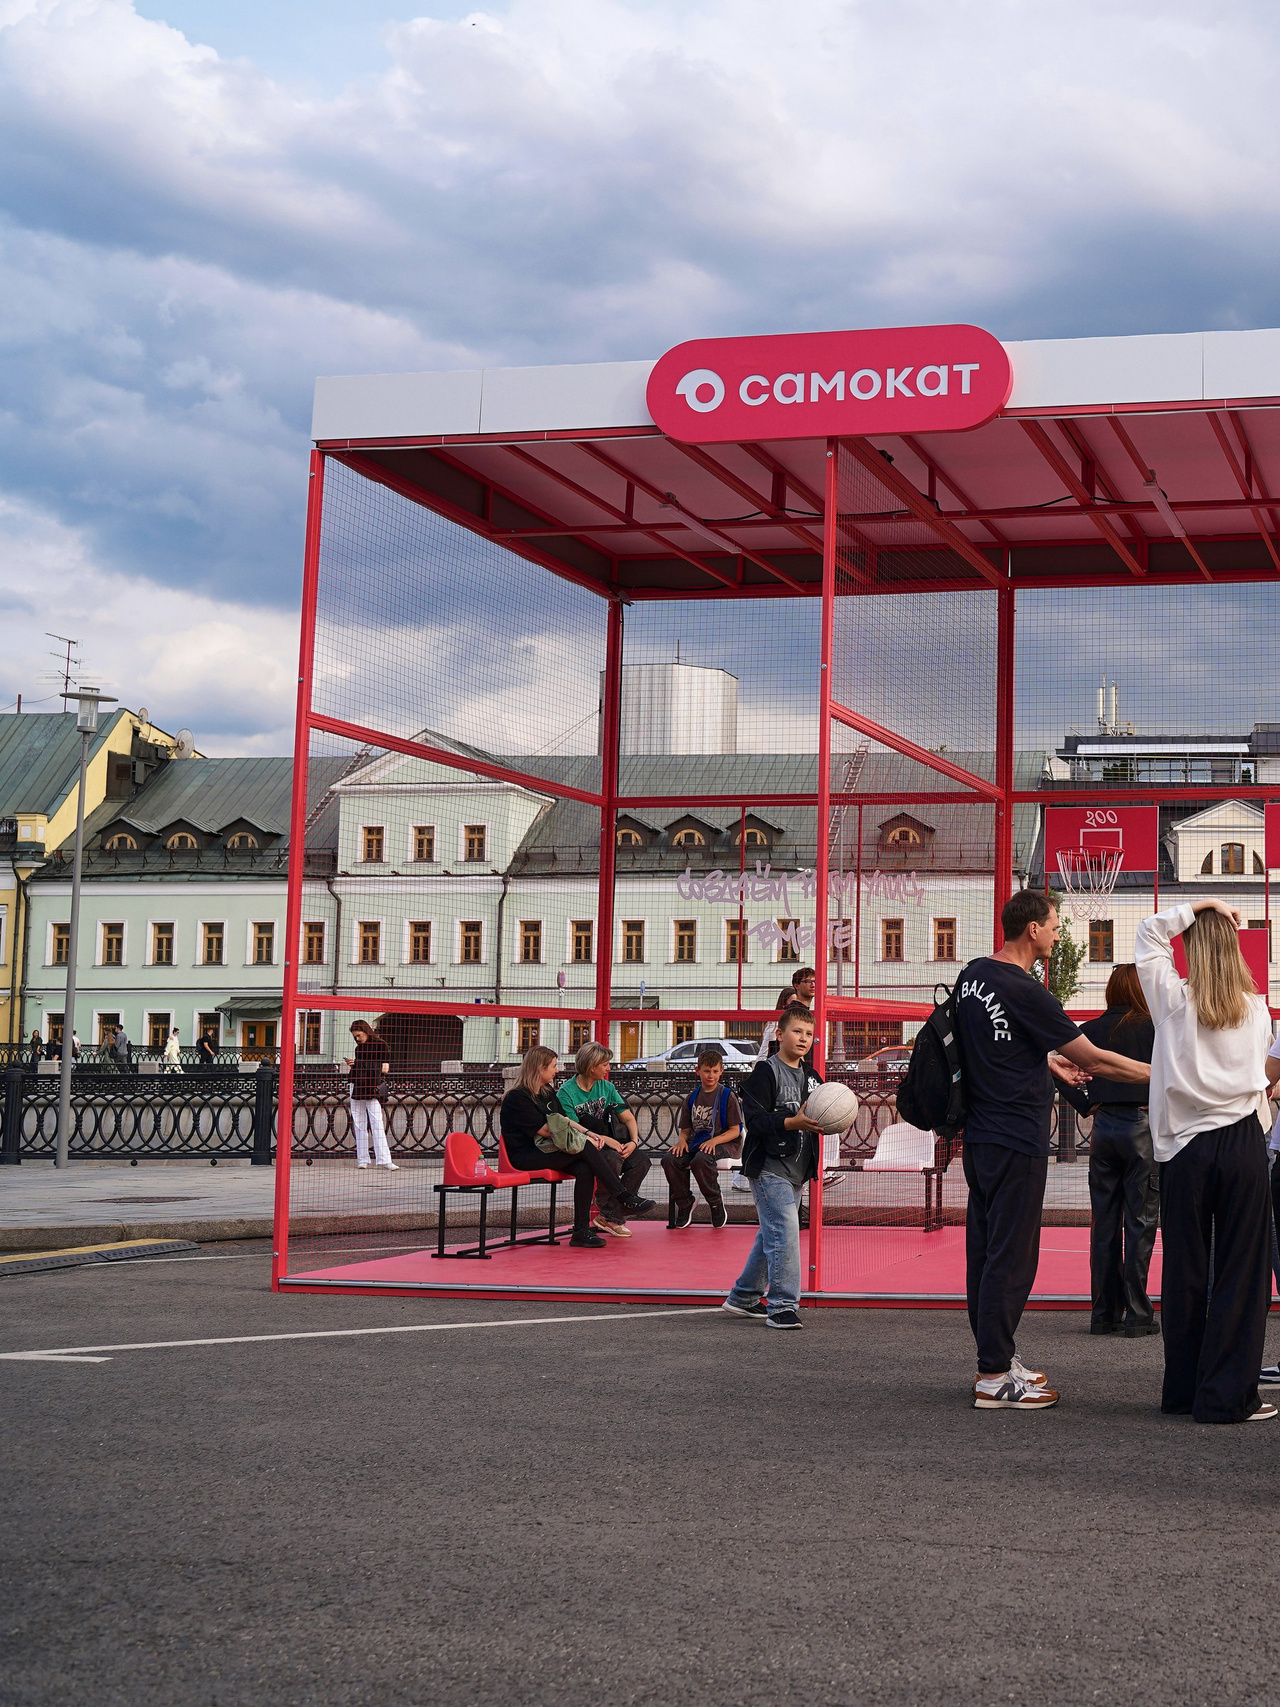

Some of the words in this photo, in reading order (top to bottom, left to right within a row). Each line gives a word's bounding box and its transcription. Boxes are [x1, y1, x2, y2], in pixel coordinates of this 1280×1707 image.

[738, 362, 980, 406] самокат
[1085, 810, 1118, 828] 200
[962, 979, 1012, 1041] BALANCE
